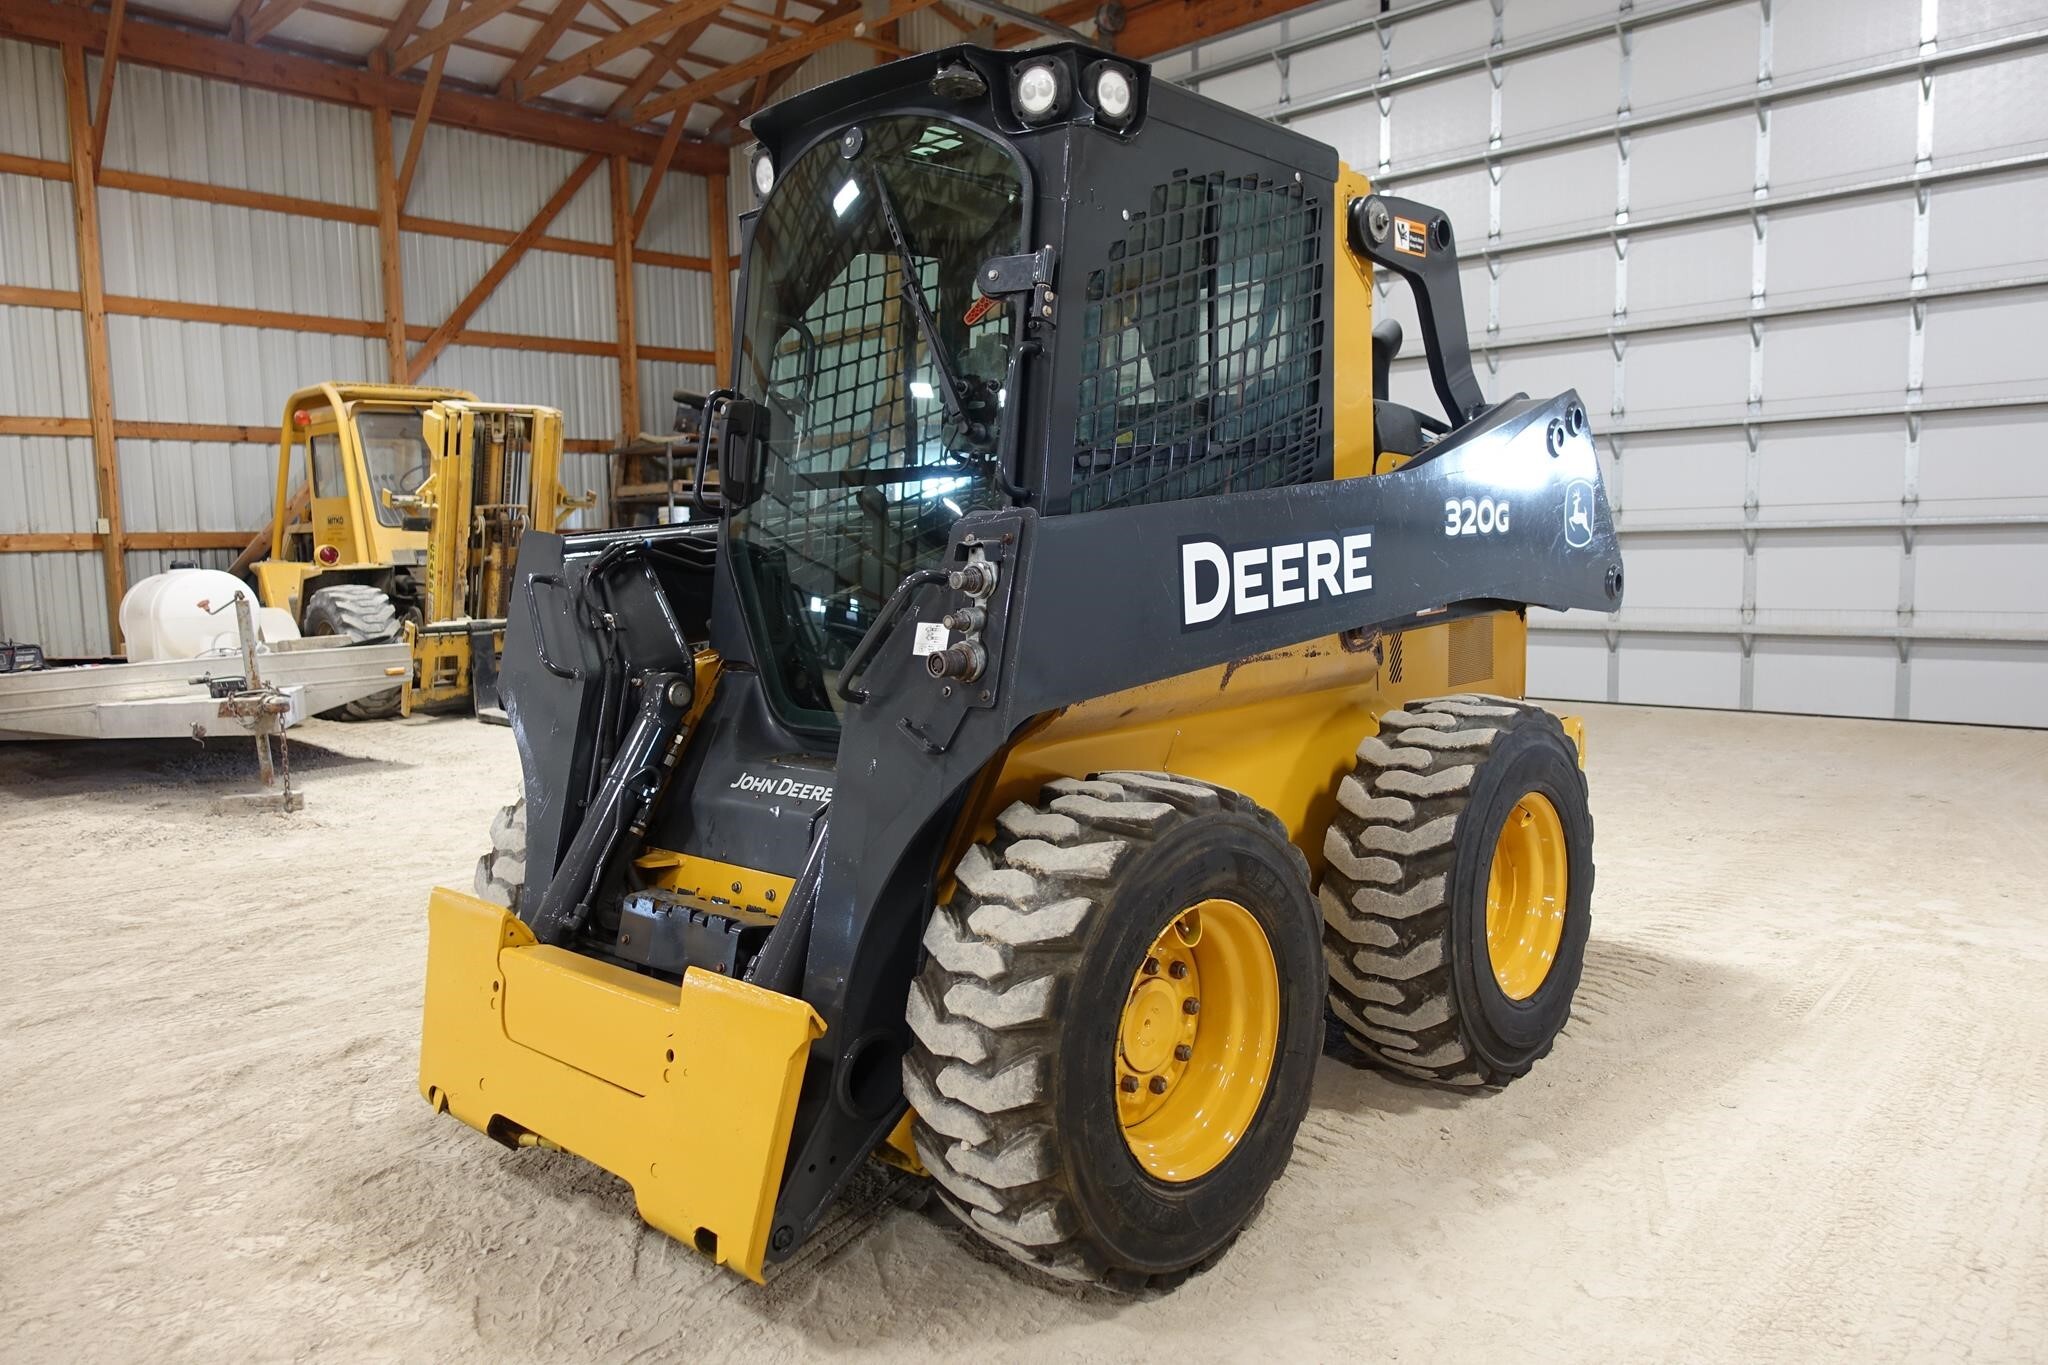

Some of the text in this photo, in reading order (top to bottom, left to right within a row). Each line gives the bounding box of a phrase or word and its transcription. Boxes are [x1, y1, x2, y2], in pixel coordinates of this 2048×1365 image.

[1445, 498, 1510, 537] 320G
[1182, 532, 1373, 625] DEERE
[730, 772, 833, 802] JOHN DEERE
